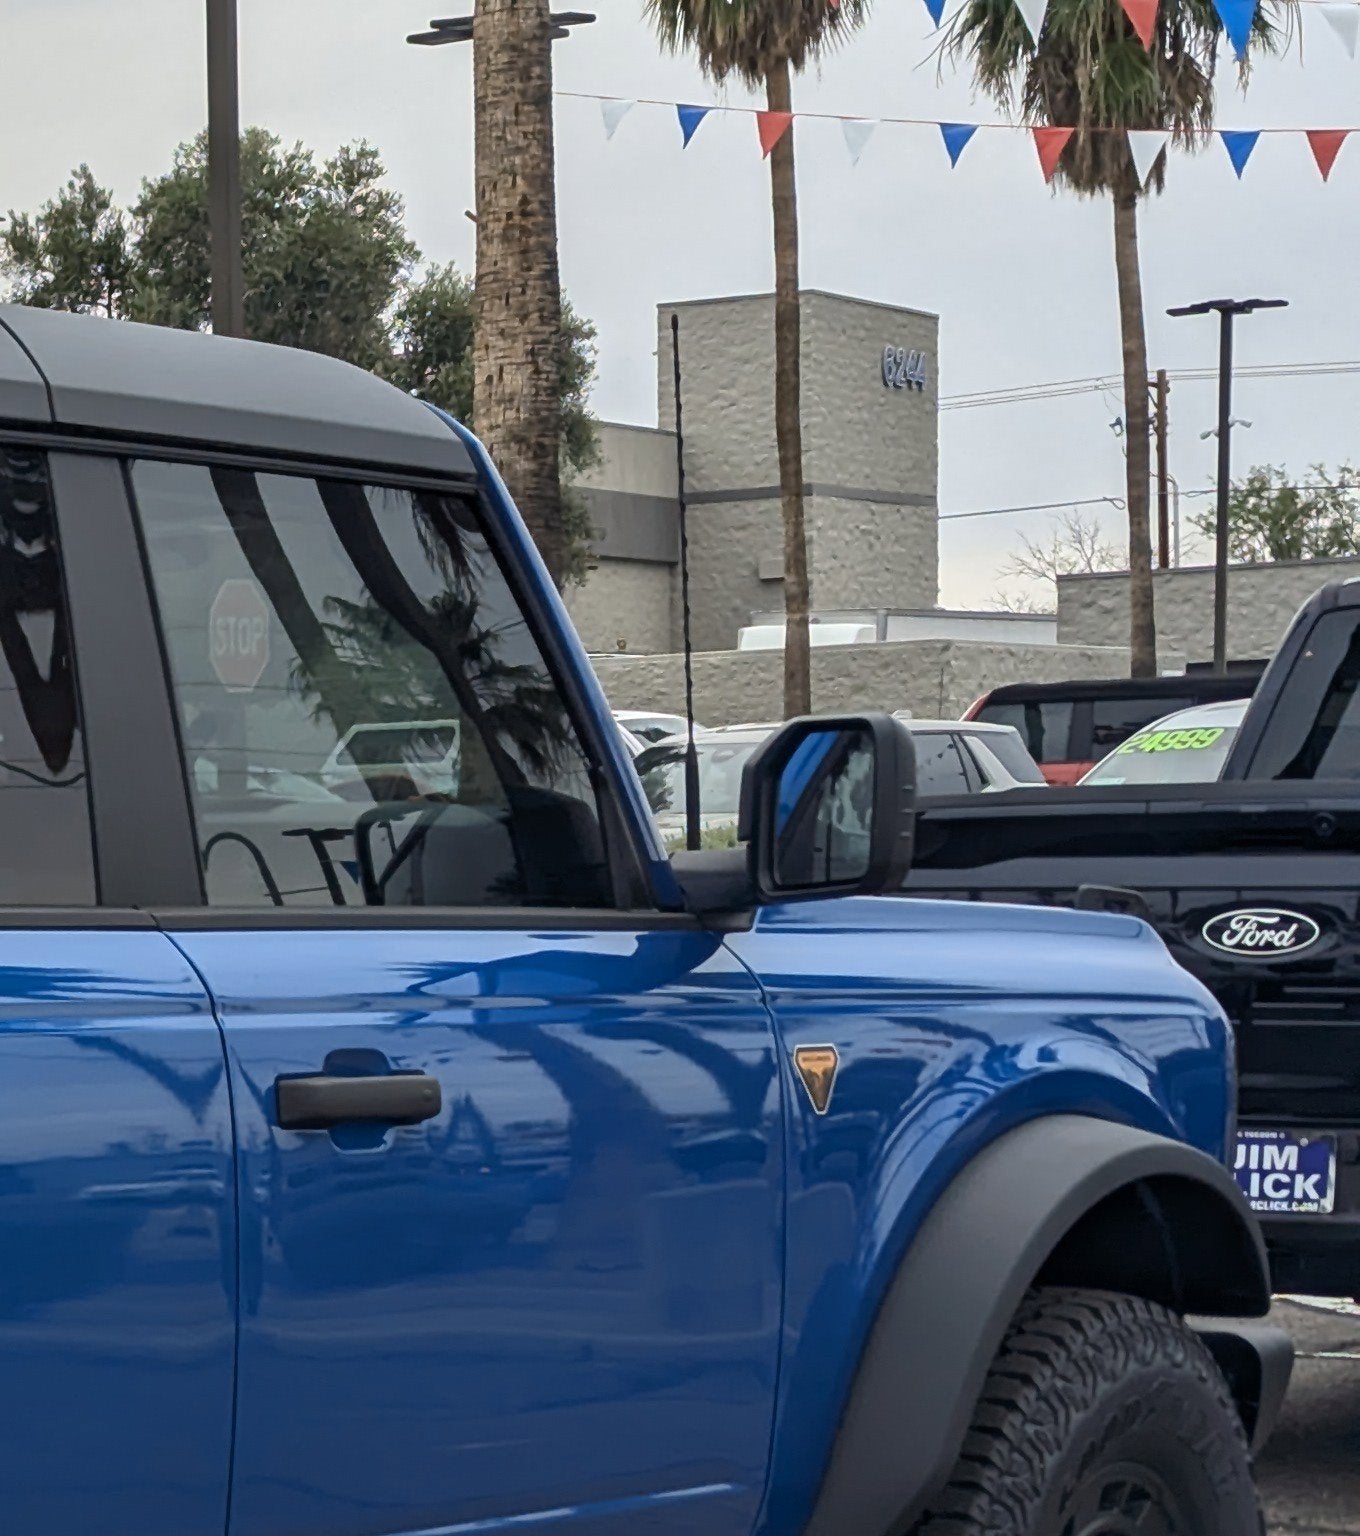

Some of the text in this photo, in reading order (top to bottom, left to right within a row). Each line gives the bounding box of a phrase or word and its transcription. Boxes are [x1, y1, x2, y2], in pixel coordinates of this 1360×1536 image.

[215, 616, 264, 656] STOP
[1118, 727, 1225, 754] 24999
[1221, 914, 1299, 947] Ford
[1233, 1144, 1298, 1171] JIM
[1234, 1172, 1321, 1200] ICK
